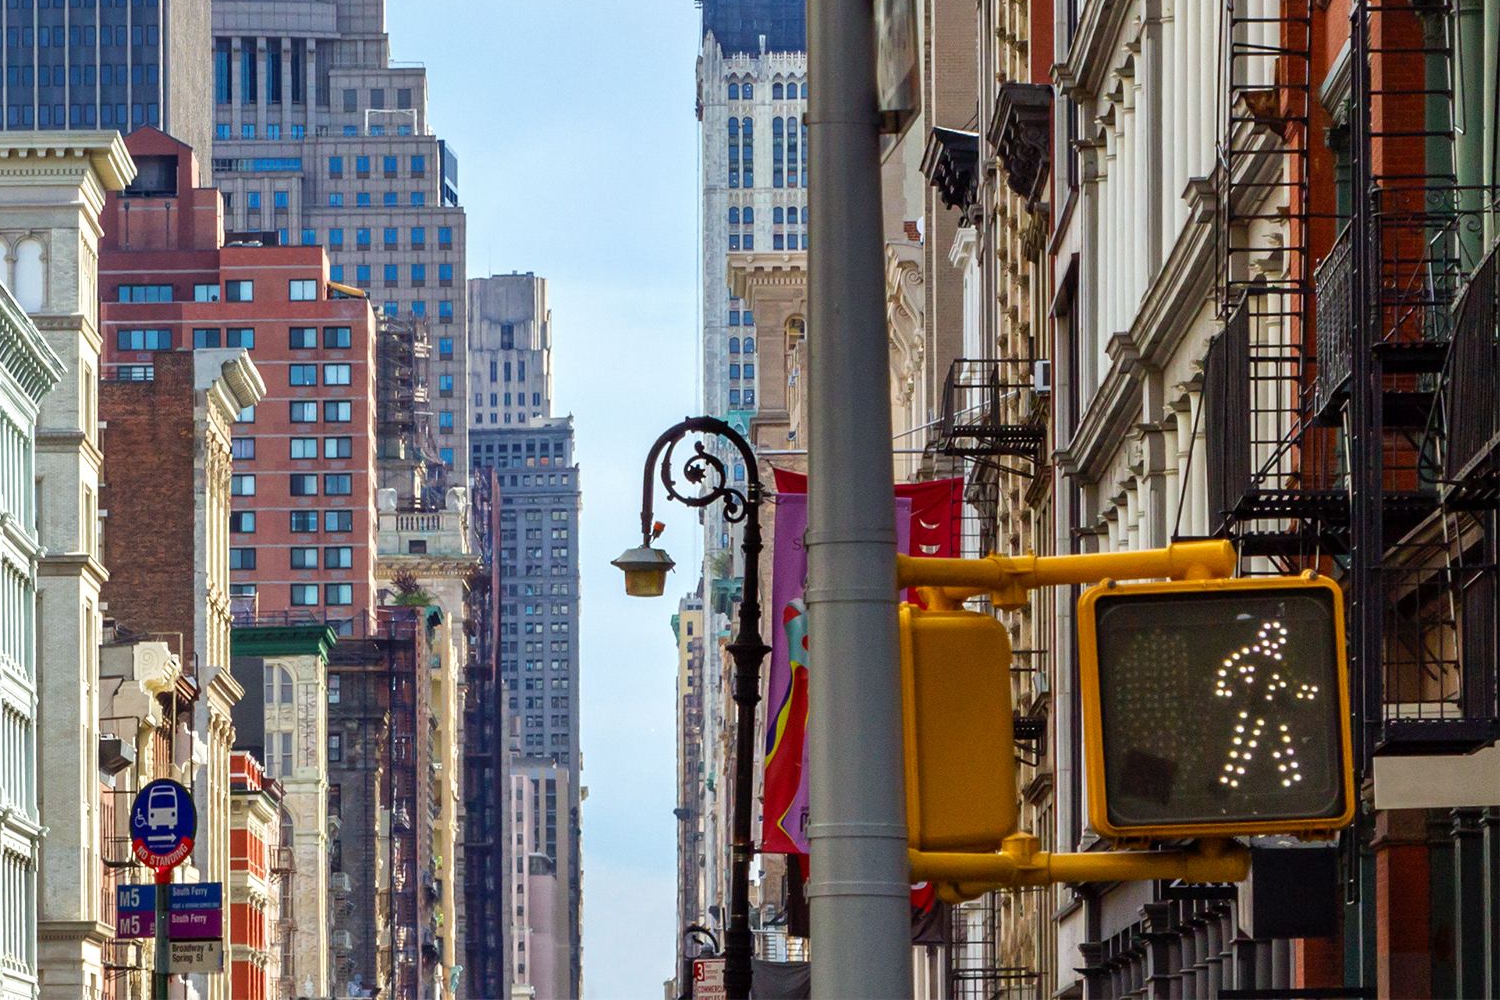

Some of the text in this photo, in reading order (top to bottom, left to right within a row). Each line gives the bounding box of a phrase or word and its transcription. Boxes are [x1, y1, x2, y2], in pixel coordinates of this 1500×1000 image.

[137, 843, 188, 866] NO STANDING
[172, 886, 208, 897] South Ferry
[120, 888, 140, 908] M5
[120, 915, 140, 935] M5
[172, 914, 207, 925] South Ferry
[172, 943, 214, 954] Broadway &
[172, 953, 204, 964] Spring St
[697, 964, 704, 980] 3
[698, 985, 725, 993] COMMERCIA
